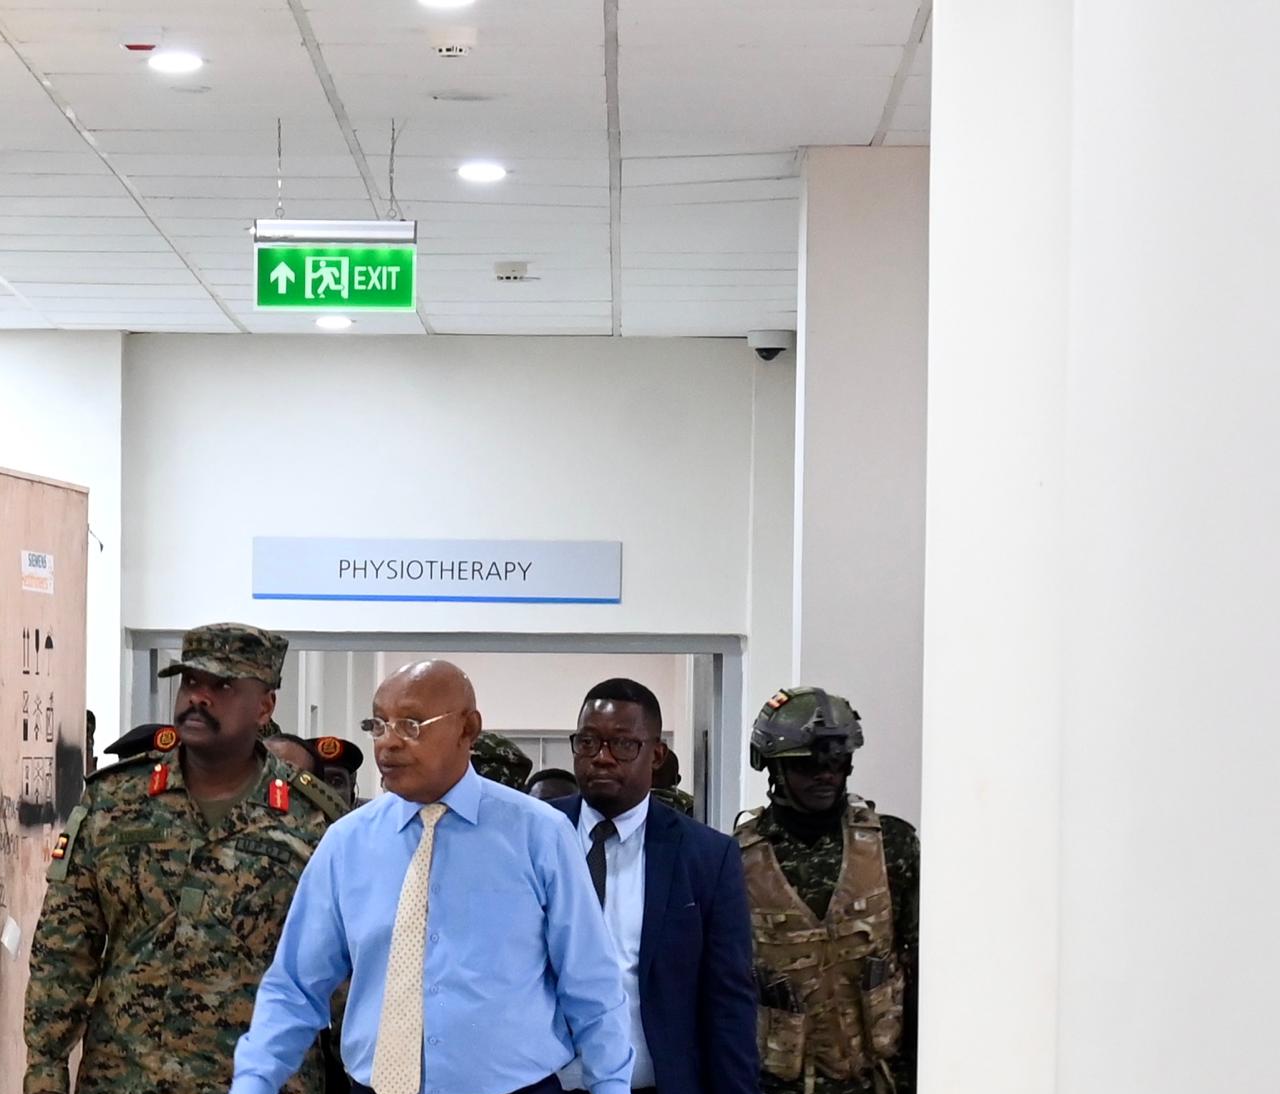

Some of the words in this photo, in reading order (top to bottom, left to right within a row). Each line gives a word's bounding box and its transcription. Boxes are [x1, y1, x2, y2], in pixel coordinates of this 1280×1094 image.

[353, 266, 401, 291] EXIT
[27, 552, 48, 569] SIEMENS
[338, 559, 533, 581] PHYSIOTHERAPY
